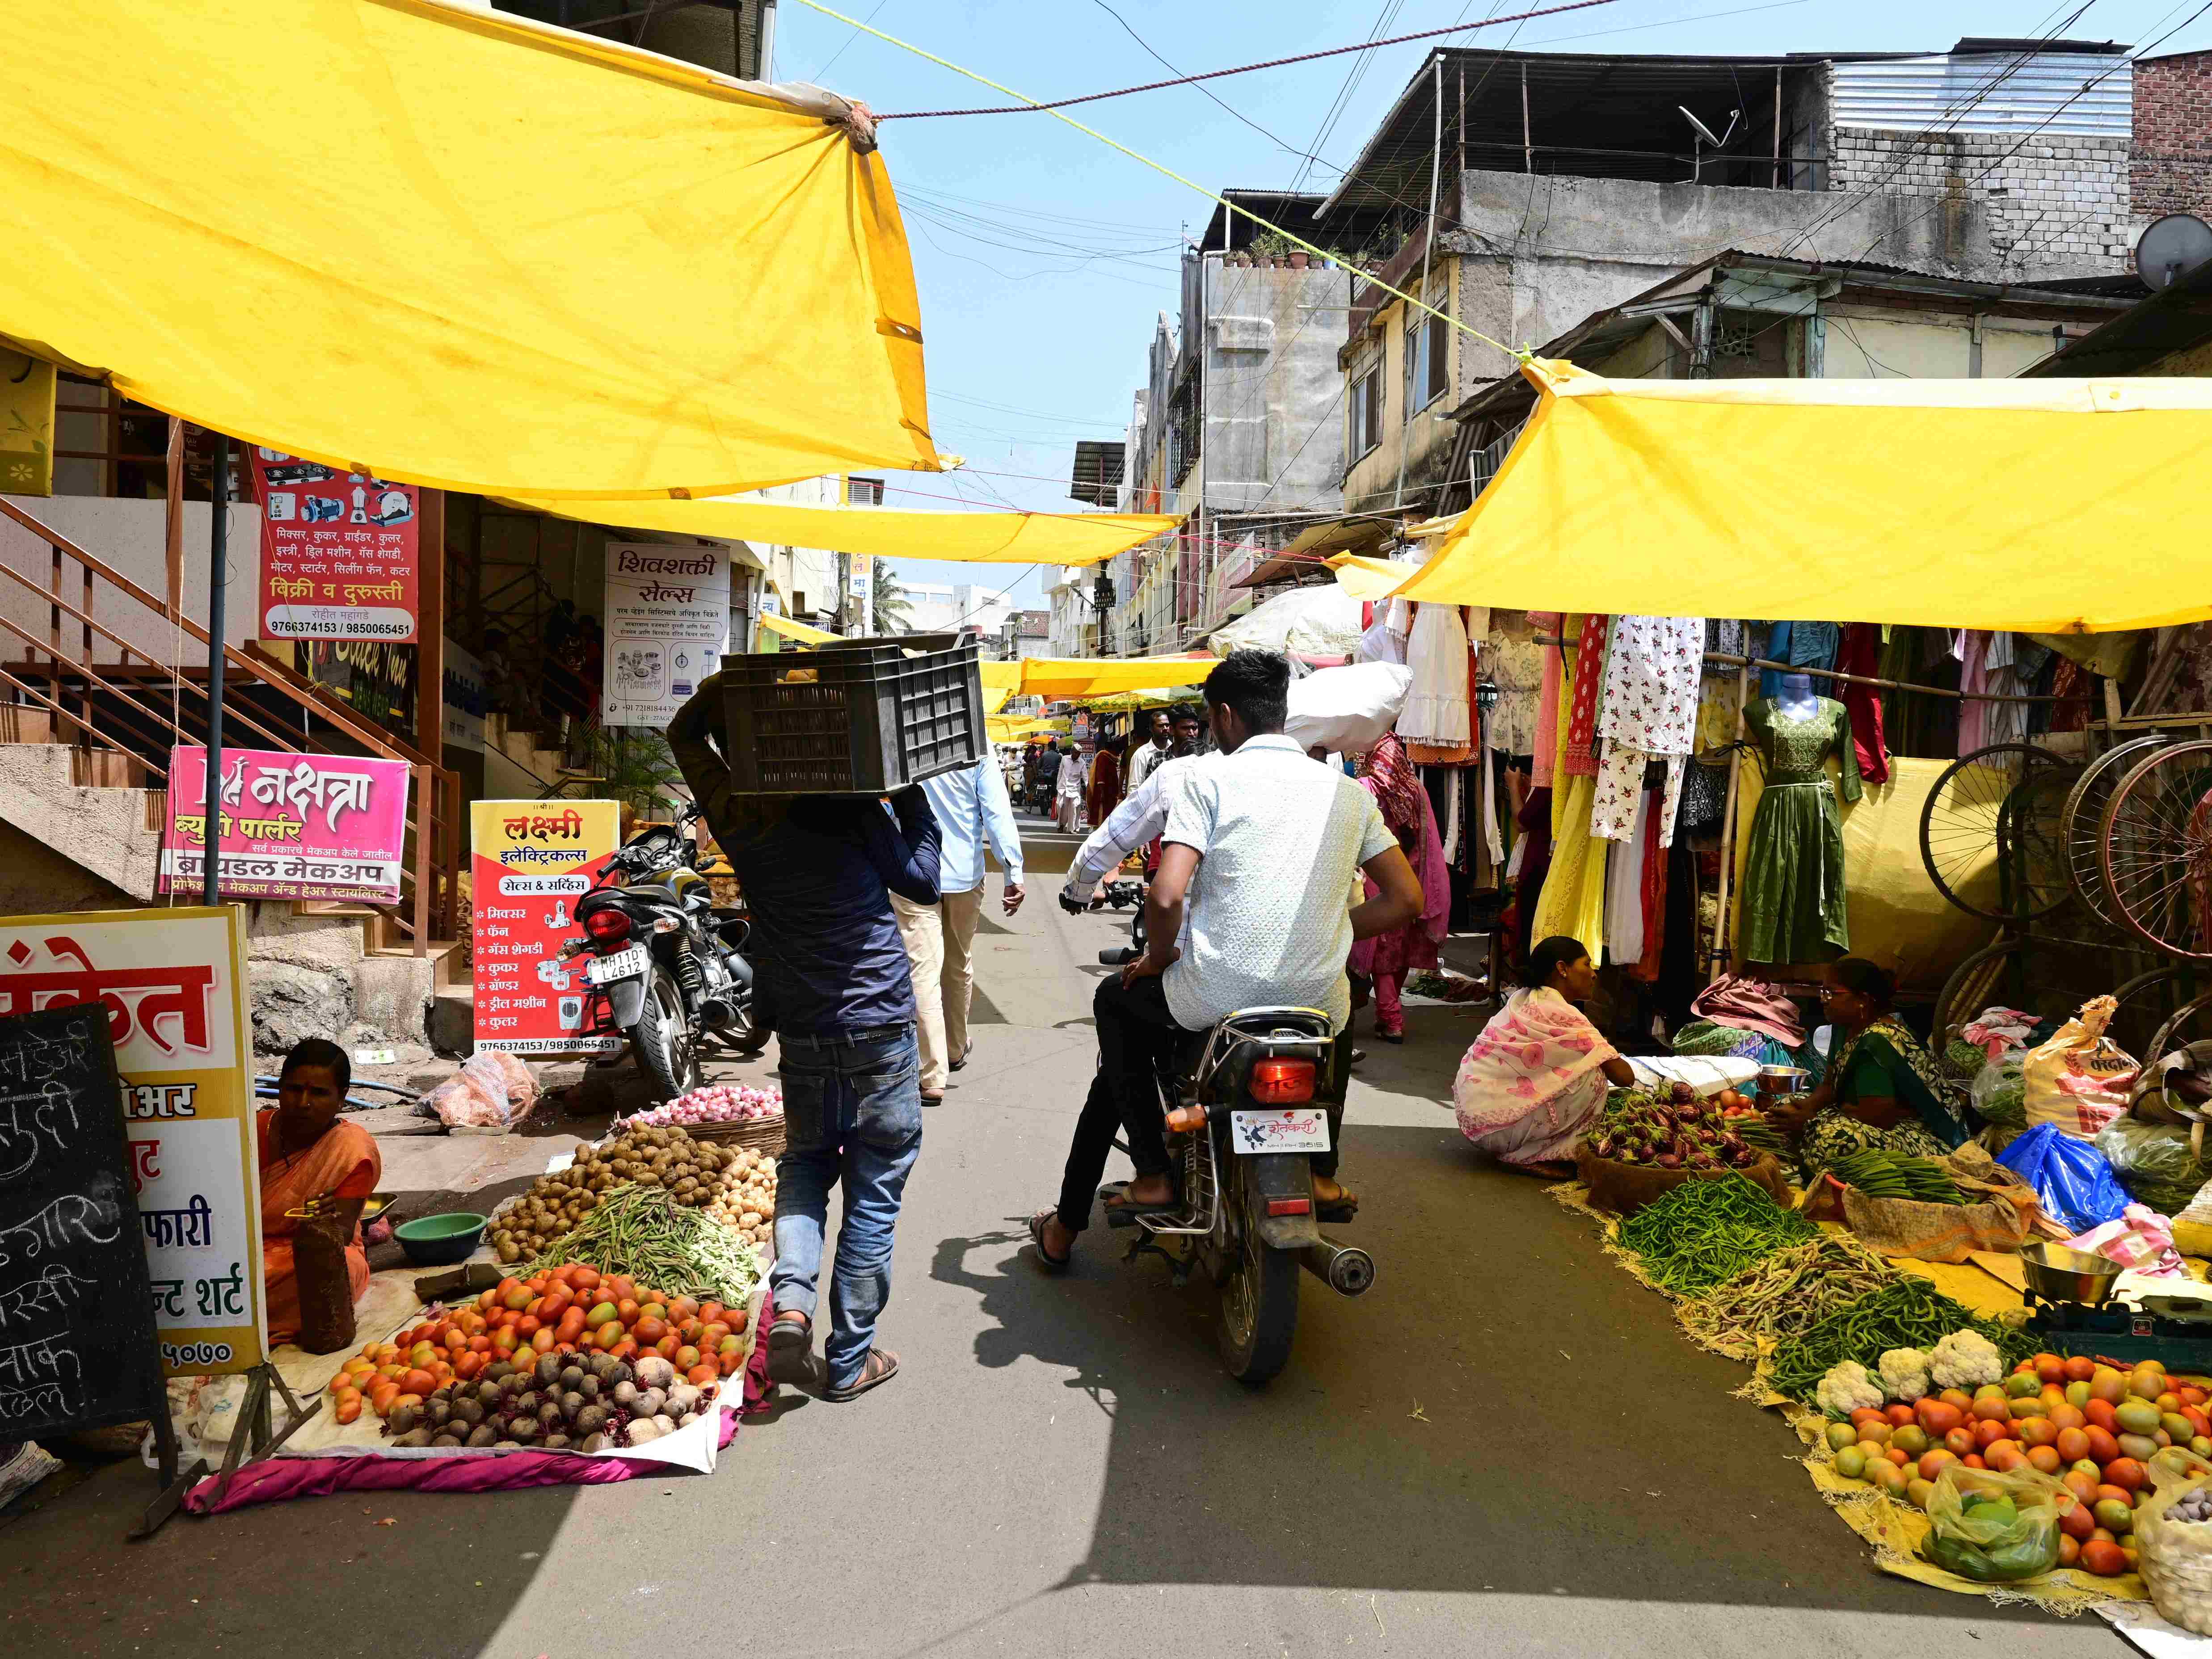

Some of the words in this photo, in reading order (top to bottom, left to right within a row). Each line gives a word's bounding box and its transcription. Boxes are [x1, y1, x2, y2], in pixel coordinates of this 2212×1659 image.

[276, 527, 309, 542] मिक्सर,
[314, 531, 340, 543] कुकर,
[379, 533, 404, 545] कुलर,
[276, 543, 301, 557] इस्त्री,
[305, 545, 323, 559] ड्रिल
[327, 545, 354, 560] मशीन,
[359, 546, 373, 558] गॅस
[377, 547, 404, 561] शेगडी,
[270, 560, 295, 574] मोटर,
[300, 561, 329, 575] स्टार्टर,
[334, 562, 363, 575] सिलींग
[366, 563, 385, 577] फॅन,
[390, 567, 410, 576] कटर
[618, 551, 717, 576] शिवशक्ती
[322, 584, 336, 598] व
[343, 580, 403, 606] दुरुस्ती
[638, 581, 696, 603] सेल्स
[312, 607, 336, 620] रोहीत
[340, 609, 369, 621] महांगडे
[679, 609, 700, 619] अधिकृत
[272, 621, 336, 632] 9766374153
[340, 623, 343, 632] /
[346, 623, 409, 635] 9850065451
[239, 812, 303, 842] पार्लर
[503, 809, 583, 843] लक्ष्मी
[252, 843, 268, 853] सर्व
[271, 844, 303, 855] प्रकारचे
[307, 846, 337, 857] मेकअप
[342, 848, 358, 859] केले
[362, 849, 393, 860] जातील
[500, 846, 587, 865] इलेक्ट्रिकल्स
[283, 857, 384, 882] मेकअप
[229, 880, 267, 894] मेकअप
[302, 882, 326, 897] हेअर
[331, 884, 386, 900] स्टायलिस्ट
[503, 879, 532, 892] सेल्स
[536, 880, 544, 890] &
[547, 877, 585, 891] सर्व्हिस
[487, 907, 526, 920] मिक्सर
[487, 925, 509, 937] फॅन
[488, 943, 508, 956] गॅस
[511, 941, 544, 956] शेगडी
[601, 949, 639, 968] MH11D
[488, 963, 519, 976] कुकर
[603, 961, 641, 981] L4612
[489, 997, 510, 1013] ड्रील
[512, 996, 547, 1008] मशीन
[489, 1016, 518, 1029] कुलर
[480, 1039, 615, 1052] 9766374153/9850065451
[1266, 1119, 1317, 1140] शेतकरी
[196, 1263, 244, 1316] शर्ट
